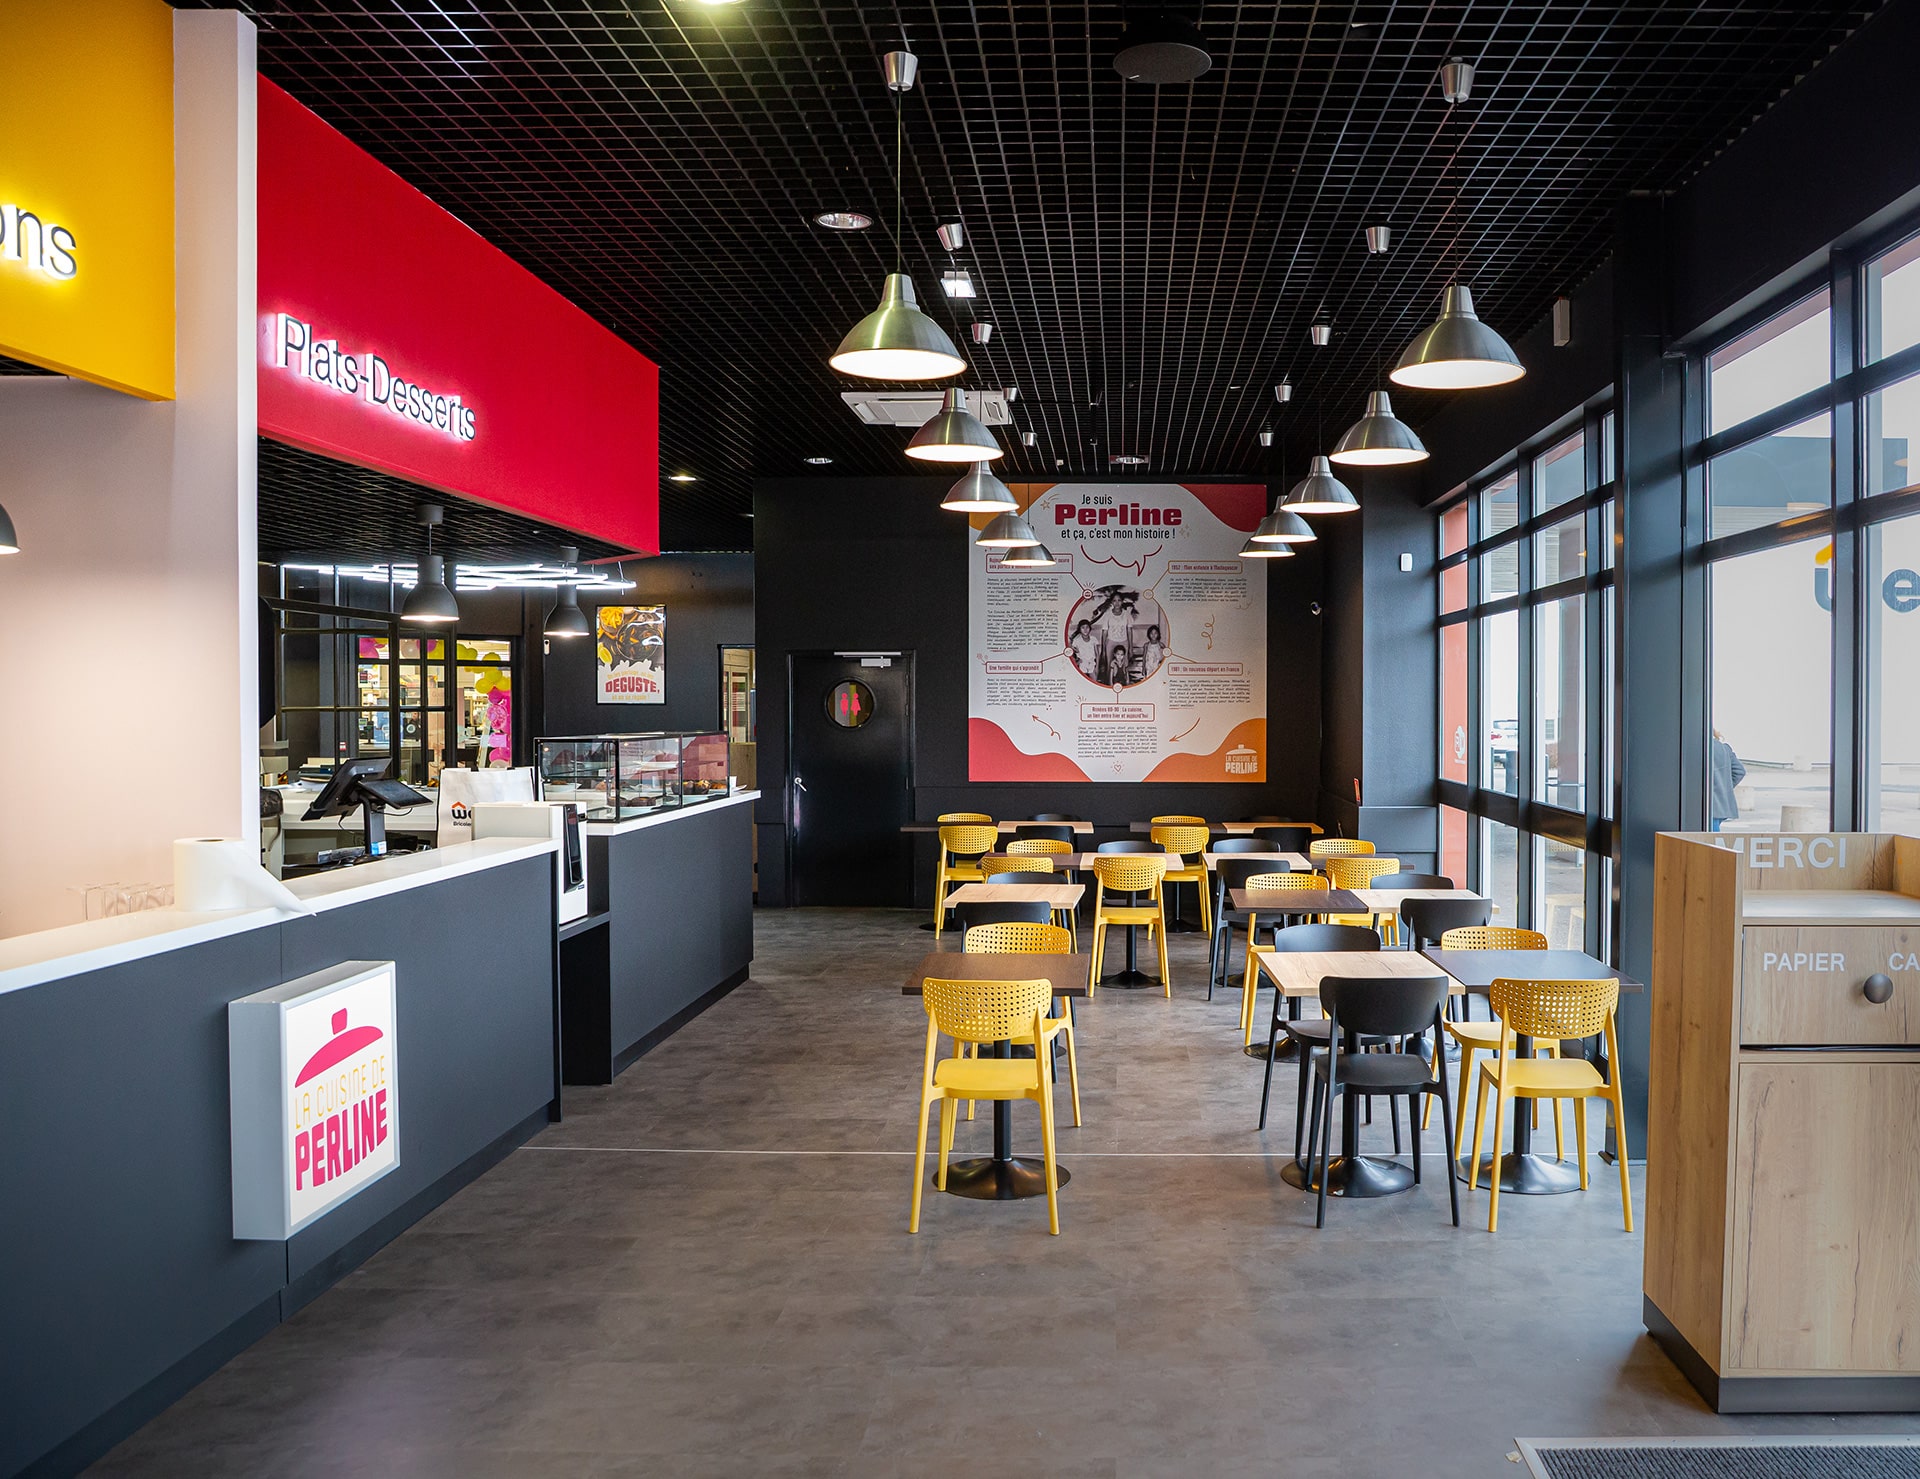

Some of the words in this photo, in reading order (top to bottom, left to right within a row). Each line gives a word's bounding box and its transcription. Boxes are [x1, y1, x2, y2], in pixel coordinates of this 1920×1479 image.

[0, 205, 77, 279] ns
[277, 312, 476, 441] Plats-Desserts
[1081, 494, 1091, 505] Je
[1094, 494, 1113, 505] suis
[1055, 502, 1182, 526] Perline
[1061, 529, 1070, 539] et
[1073, 530, 1086, 541] ça,
[1089, 528, 1111, 539] c'est
[1114, 530, 1132, 539] mon
[1135, 528, 1170, 539] histoire
[1225, 762, 1258, 774] PERLINE
[1763, 952, 1845, 972] PAPIER
[295, 1092, 310, 1130] LA
[316, 1064, 367, 1118] CUISINE
[372, 1055, 385, 1090] DE
[295, 1087, 388, 1191] PERLINE
